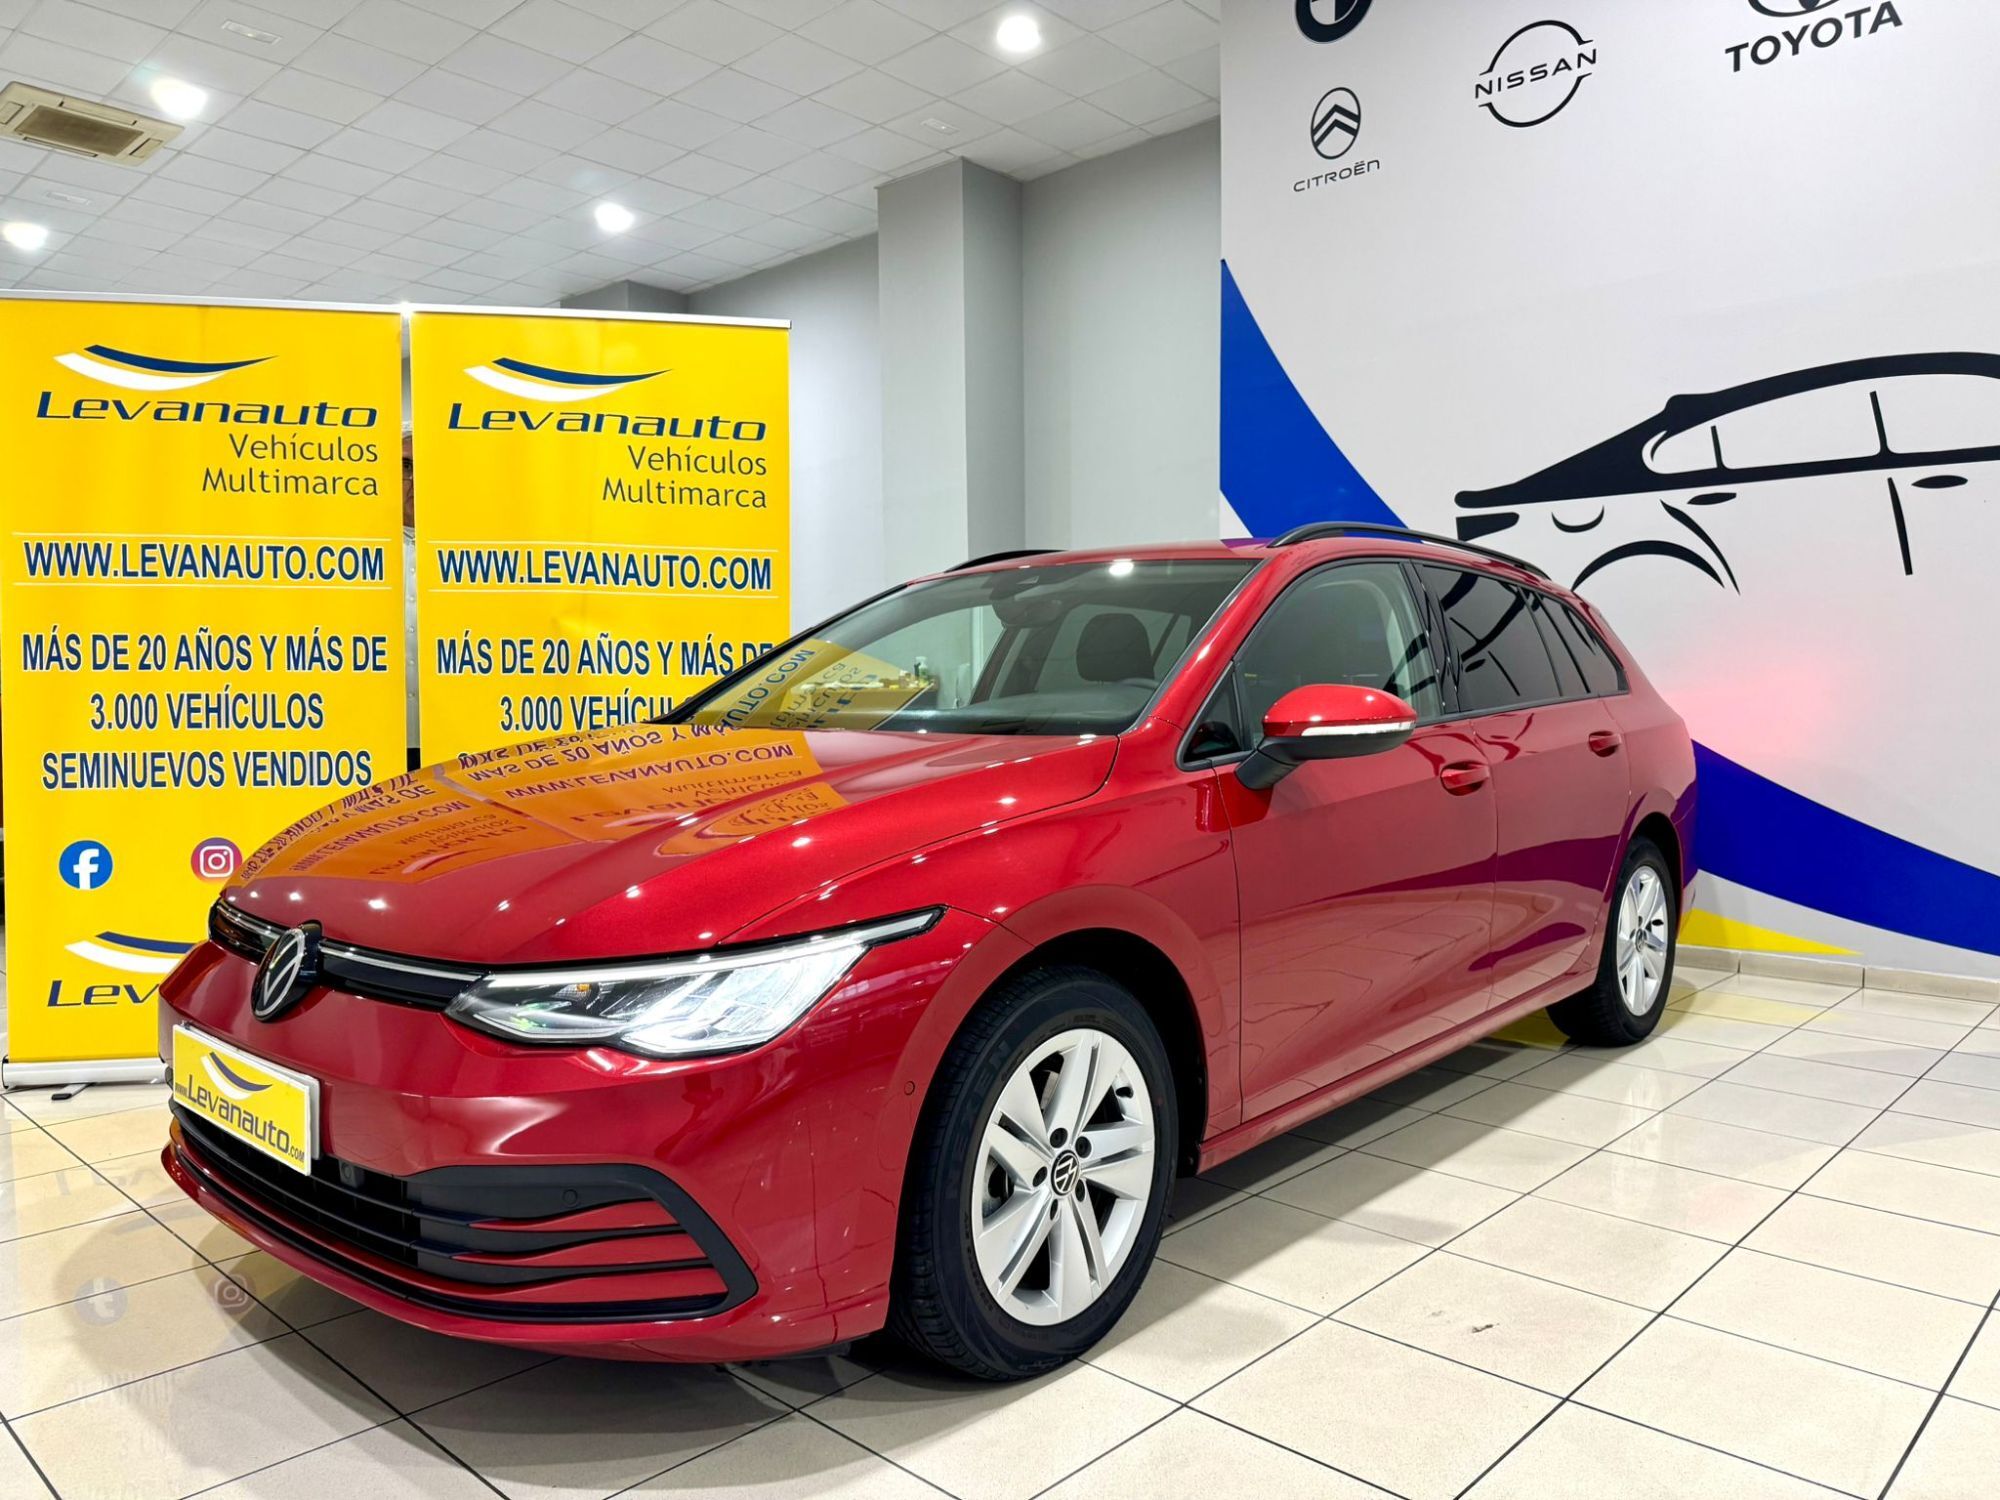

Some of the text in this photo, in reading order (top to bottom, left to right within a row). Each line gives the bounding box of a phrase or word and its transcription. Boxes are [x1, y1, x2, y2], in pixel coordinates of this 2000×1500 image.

[1725, 0, 1903, 72] TOYOTA
[1474, 48, 1598, 99] NISSAN
[36, 391, 377, 427] Levanauto
[448, 402, 766, 442] Levanauto
[229, 432, 378, 462] Vehículos
[627, 444, 767, 475] Vehículos
[202, 467, 378, 496] Multimarca
[602, 477, 767, 508] Multimarca
[24, 541, 384, 581] WWW.LEVANAUTO.COM
[437, 549, 772, 590] WWW.LEVANAUTO.COM
[22, 625, 387, 672] MÁS DE 20 AÑOS Y MÁS DE
[436, 630, 493, 674] MÁS
[500, 638, 535, 674] DE
[542, 639, 569, 674] 20
[577, 632, 650, 675] AÑOS
[656, 641, 674, 675] Y
[681, 633, 734, 675] MÁS
[90, 685, 324, 730] 3.000 VEHÍCULOS
[500, 696, 563, 732] 3.000
[43, 750, 372, 789] SEMINUEVOS VENDIDOS
[47, 980, 159, 1007] Lev
